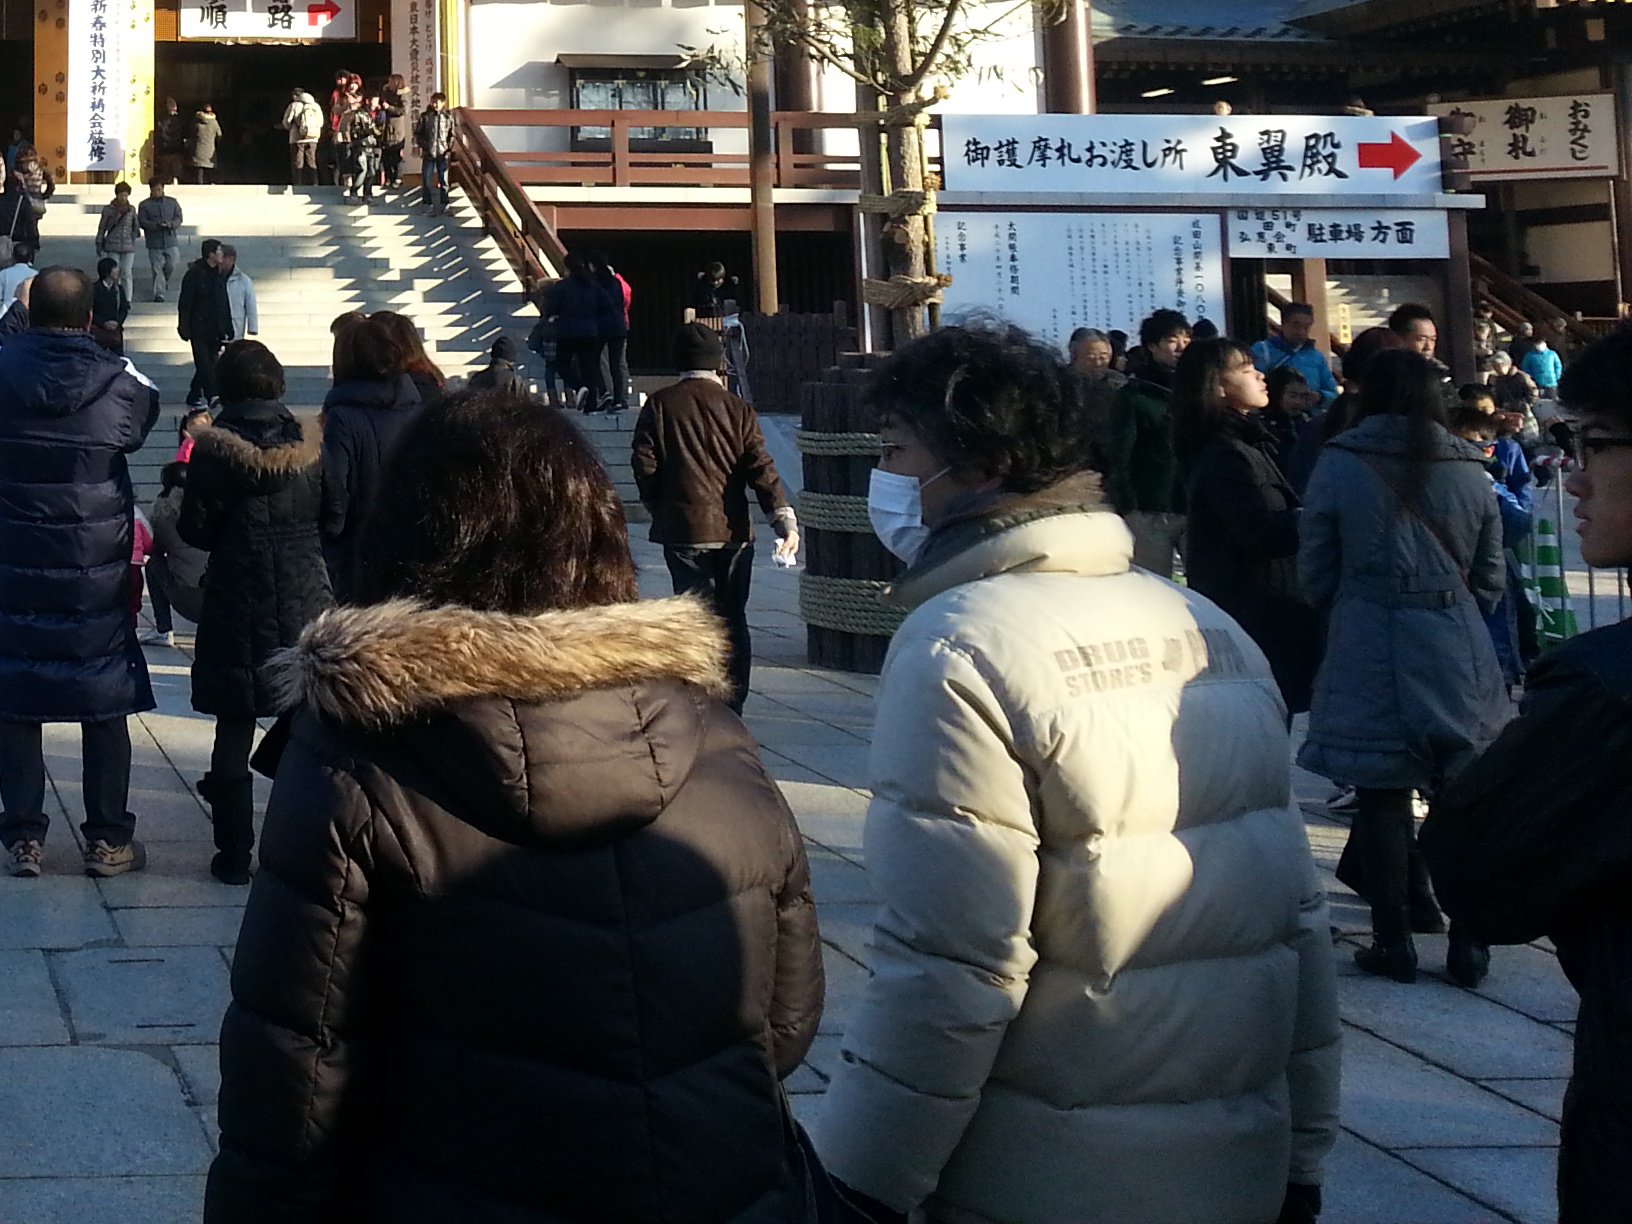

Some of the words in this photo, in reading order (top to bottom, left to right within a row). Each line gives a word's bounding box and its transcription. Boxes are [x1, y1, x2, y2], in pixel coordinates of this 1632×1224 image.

[199, 4, 296, 30] 順路
[1503, 102, 1538, 161] 御札
[1567, 99, 1592, 162] おみくじ
[963, 136, 1187, 172] 御護摩札お渡し所
[1206, 126, 1351, 184] 東翼殿
[1307, 222, 1365, 244] 駐車場
[1370, 219, 1415, 245] 方面
[1053, 637, 1151, 673] DRUG
[1065, 662, 1153, 698] STORE'S
